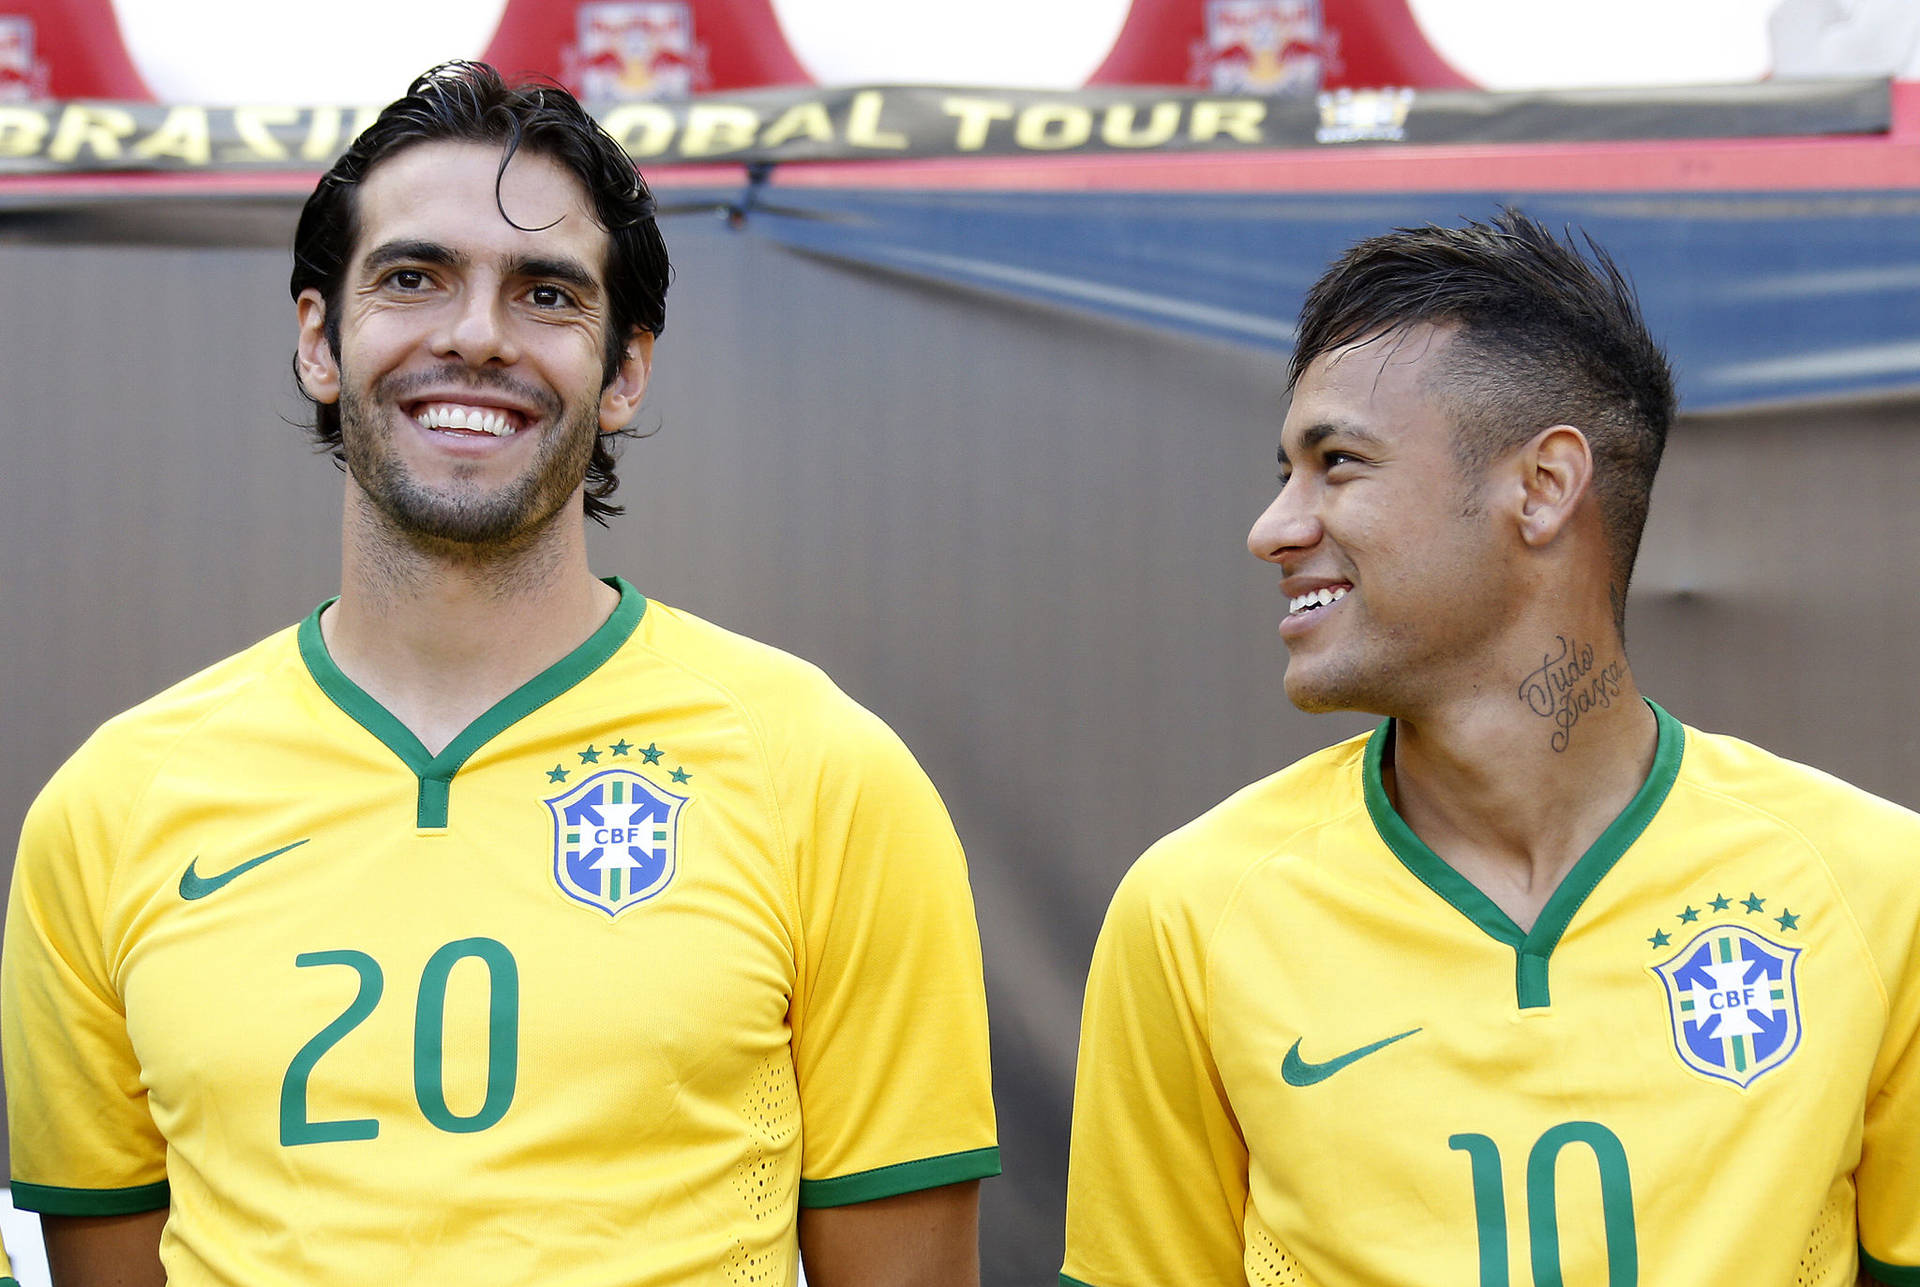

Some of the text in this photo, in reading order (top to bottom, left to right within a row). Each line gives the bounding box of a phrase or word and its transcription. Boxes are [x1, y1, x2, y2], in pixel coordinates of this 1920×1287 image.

[600, 91, 910, 157] OBAL
[942, 97, 1268, 151] TOUR
[1518, 635, 1594, 717] Tudo
[593, 827, 640, 845] CBF
[1708, 987, 1756, 1010] CBF
[279, 936, 519, 1147] 20
[1448, 1120, 1639, 1287] 10
